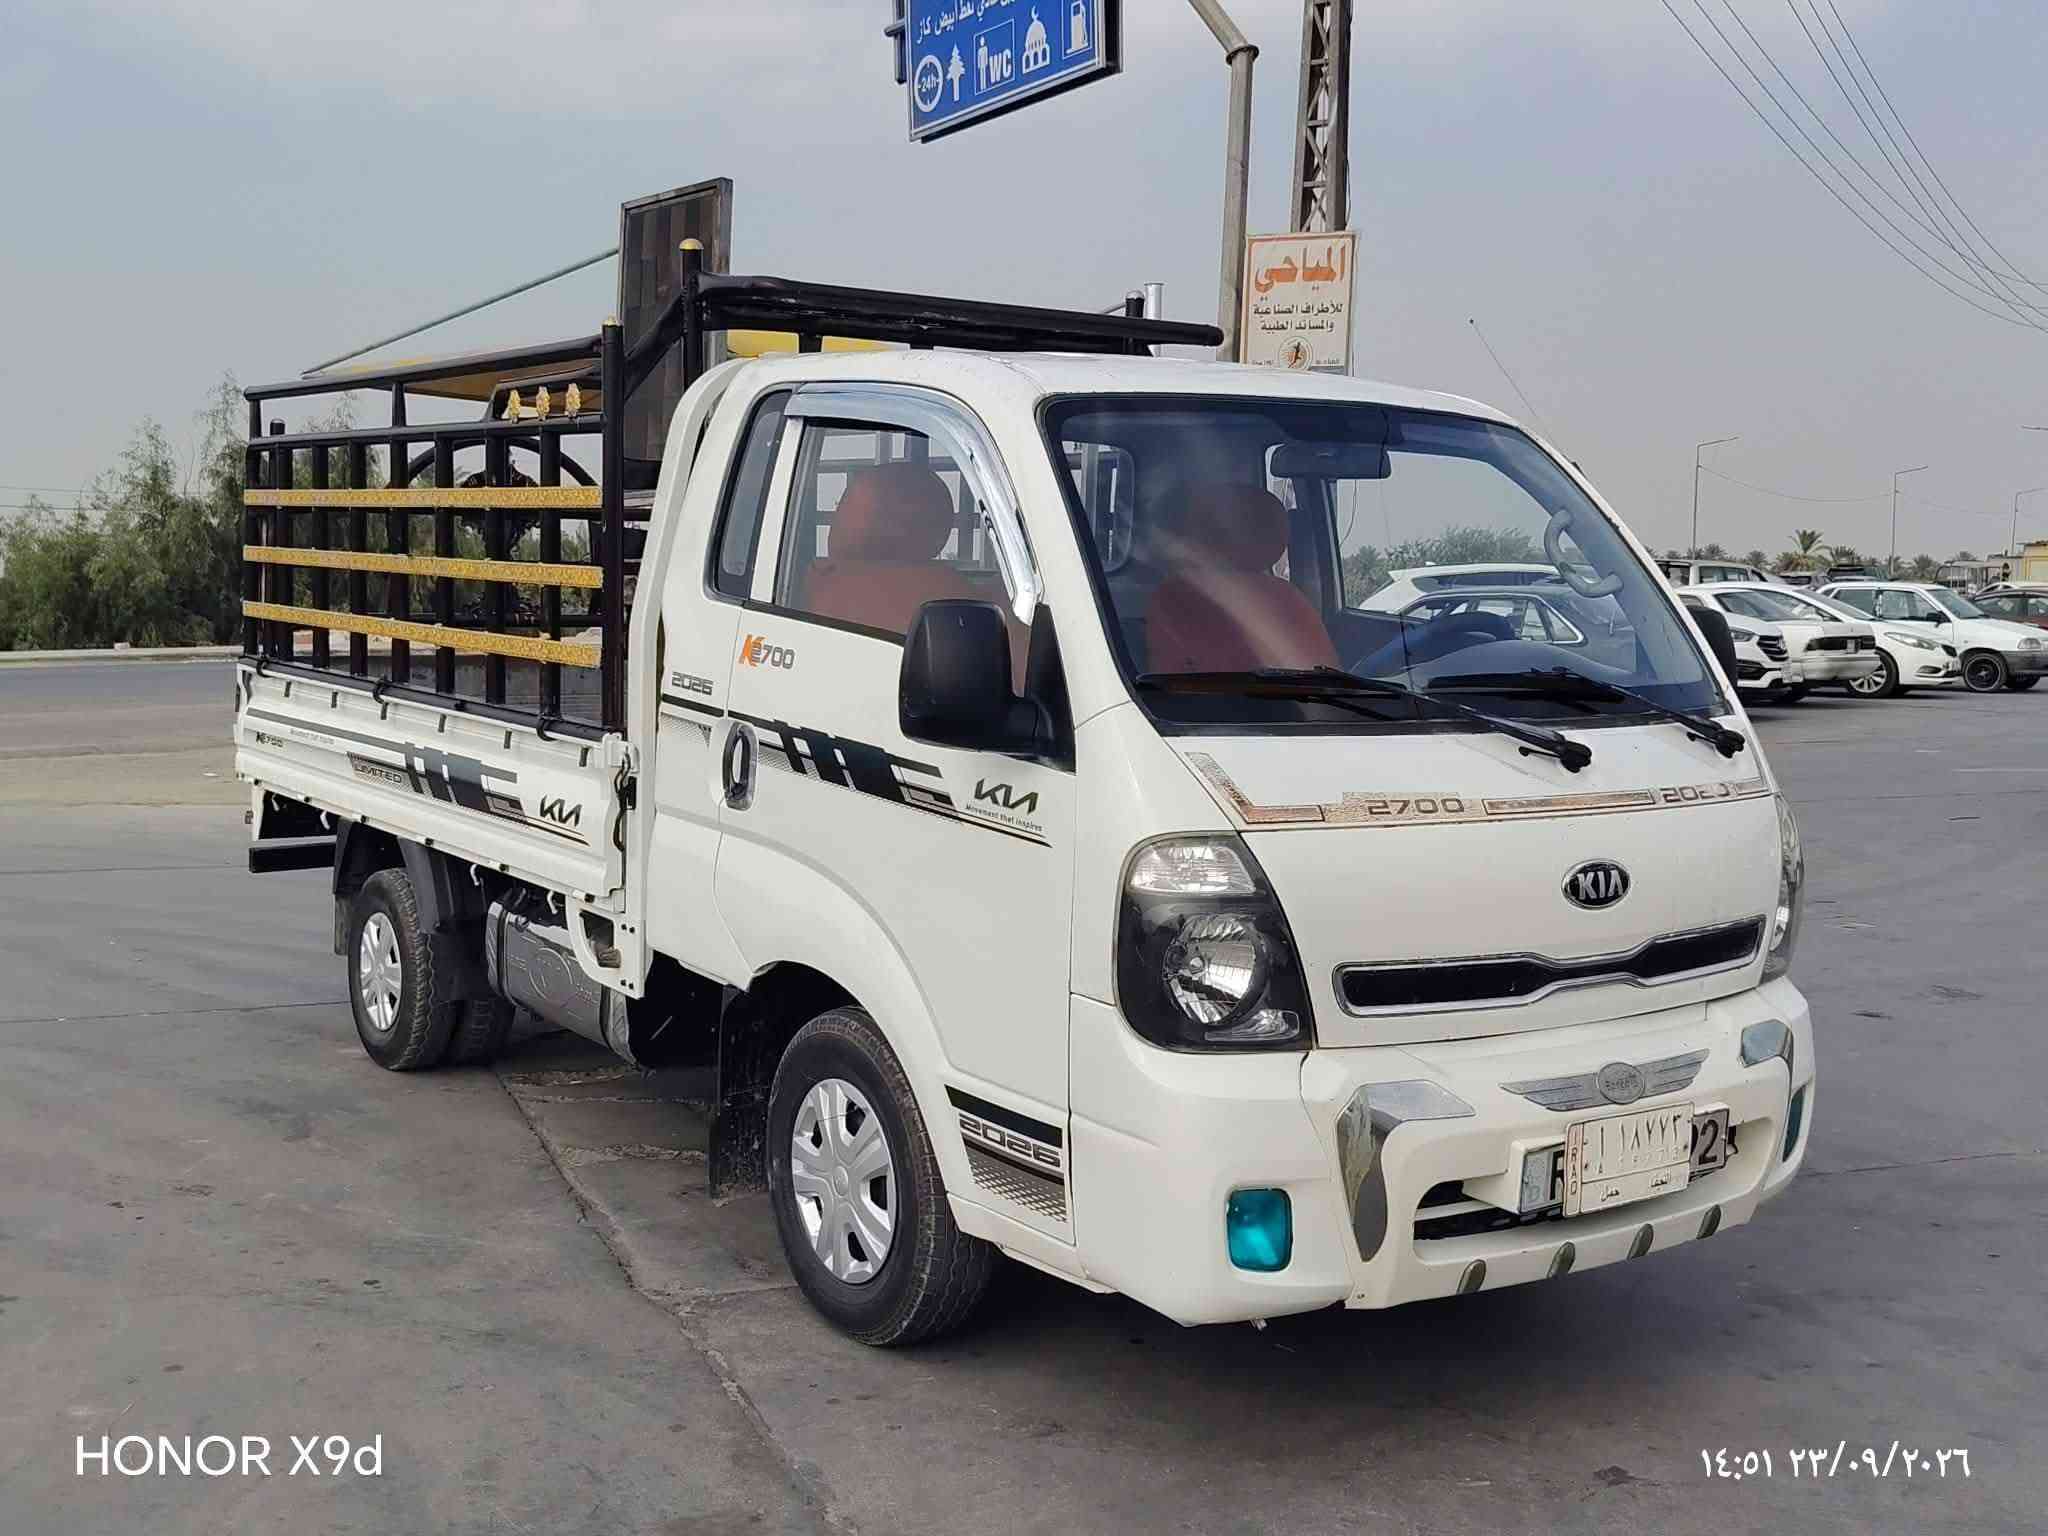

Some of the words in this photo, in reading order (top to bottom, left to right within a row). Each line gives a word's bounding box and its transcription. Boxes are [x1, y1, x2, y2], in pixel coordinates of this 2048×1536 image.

[989, 49, 1012, 83] WC
[1254, 245, 1345, 301] المياحي
[1253, 303, 1299, 318] الصناعية
[671, 671, 714, 696] 2026
[1366, 797, 1465, 815] 2700
[1576, 869, 1624, 900] KIA
[958, 1112, 1062, 1168] 2026
